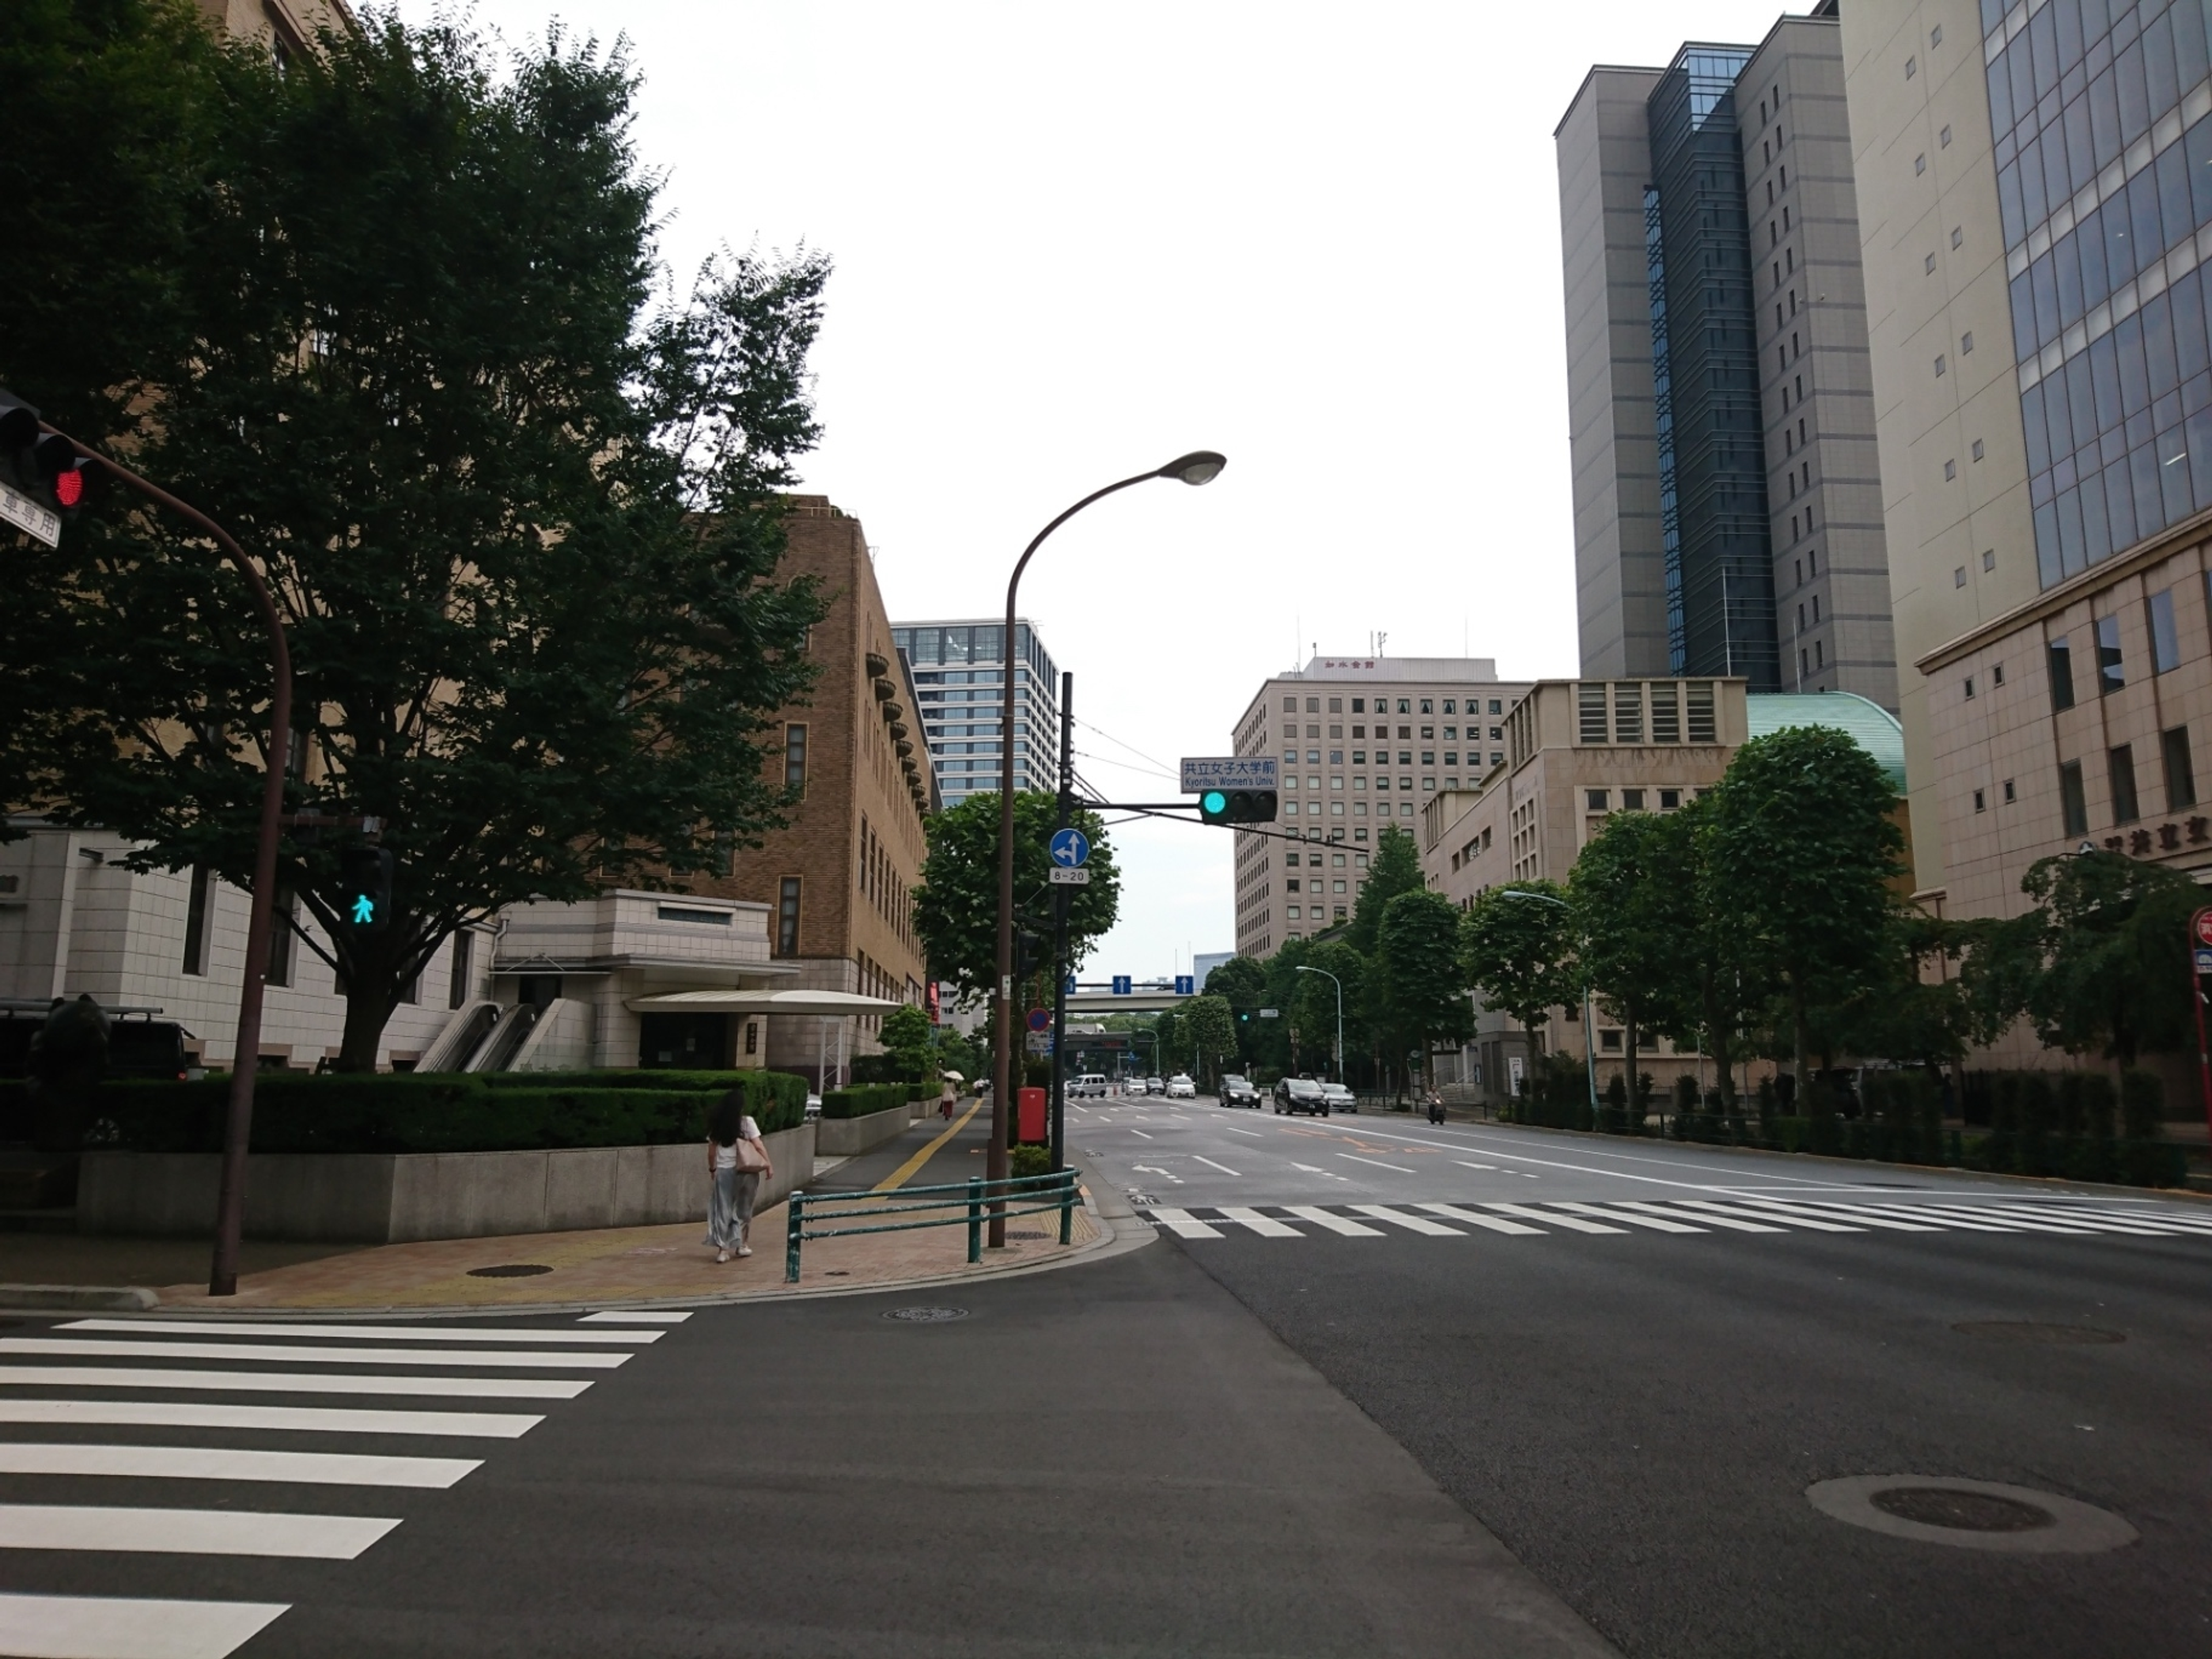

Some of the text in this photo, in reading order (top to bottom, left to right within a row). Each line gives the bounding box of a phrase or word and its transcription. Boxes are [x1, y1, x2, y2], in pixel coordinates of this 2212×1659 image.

[1184, 761, 1275, 775] 共立女子大学前
[1185, 776, 1275, 788] Kyoritsu Women's Univ.
[1054, 871, 1084, 881] 8-20
